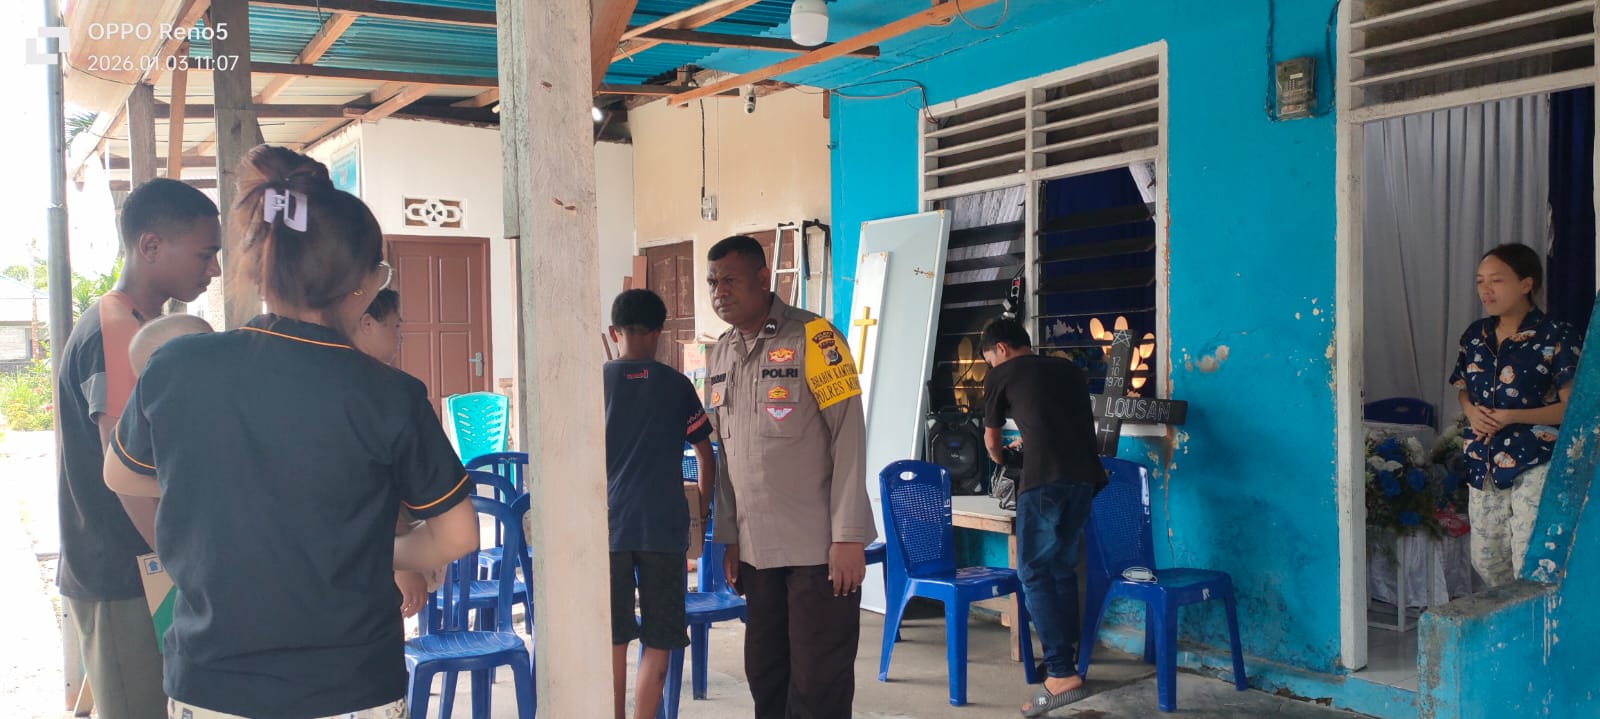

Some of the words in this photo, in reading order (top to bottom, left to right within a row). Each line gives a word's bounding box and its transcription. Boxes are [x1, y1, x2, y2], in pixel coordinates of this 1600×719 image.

[1112, 356, 1121, 366] 12
[762, 368, 798, 379] POLRI
[1105, 377, 1124, 387] 1970
